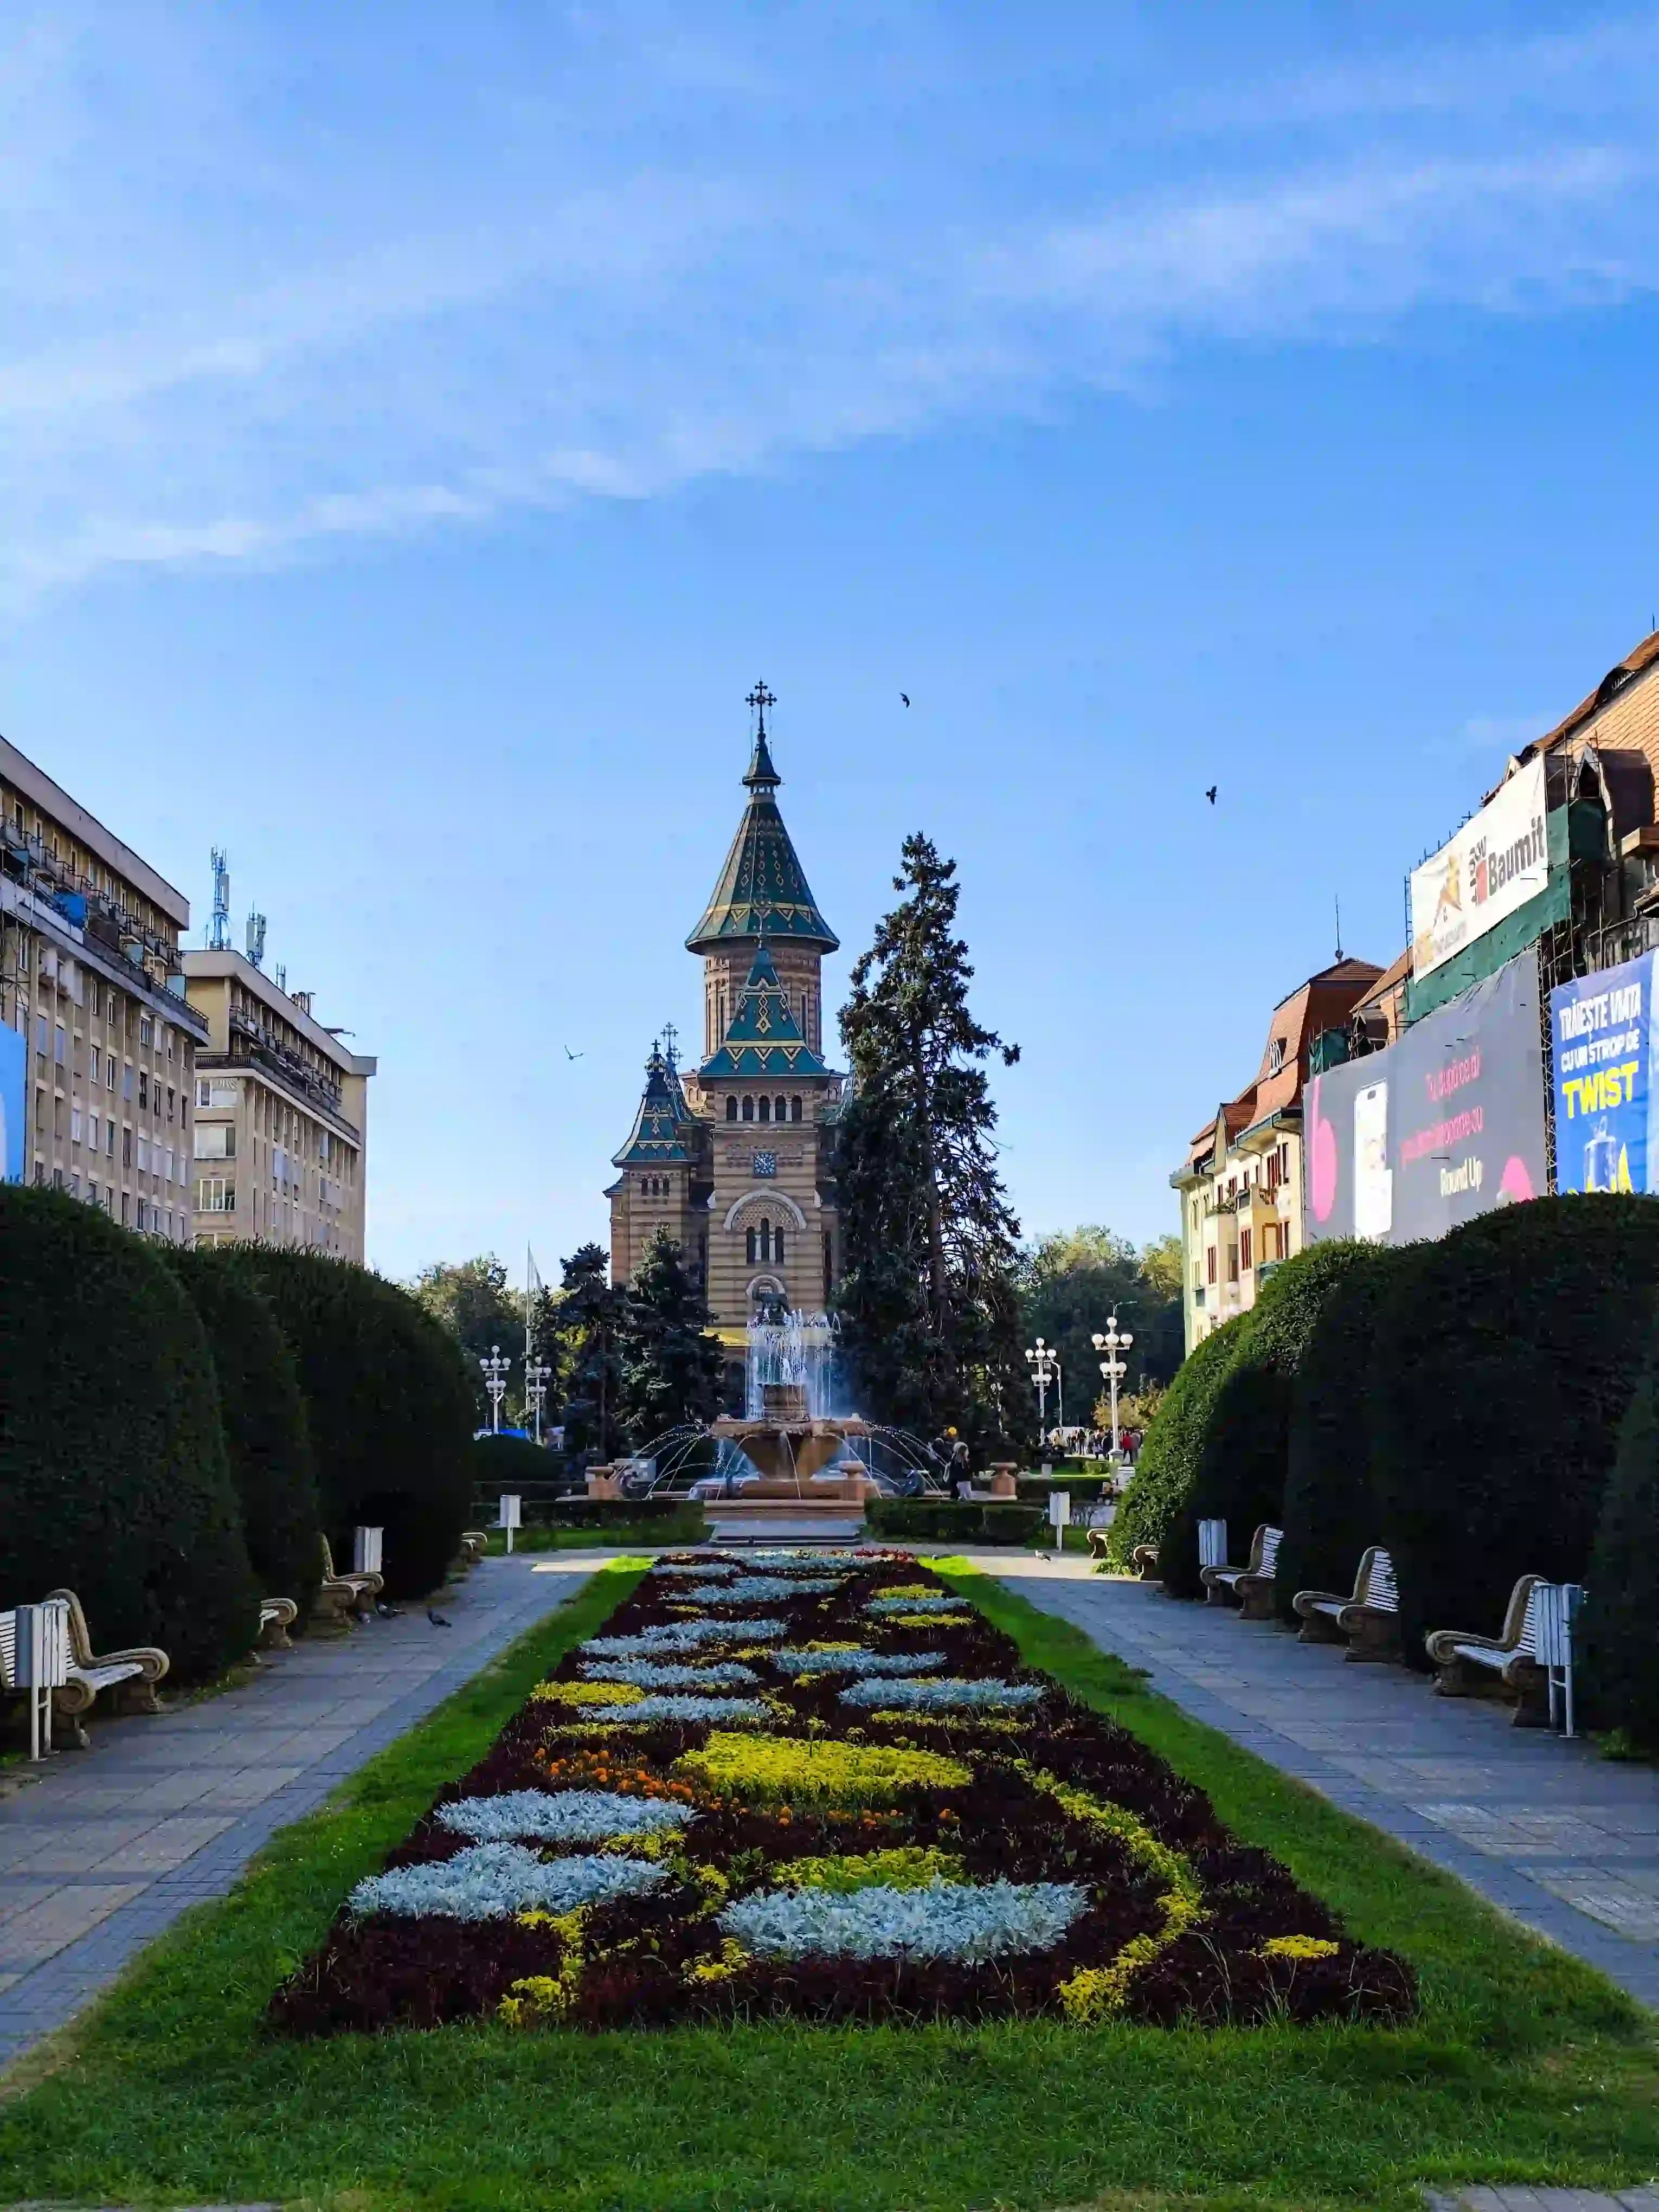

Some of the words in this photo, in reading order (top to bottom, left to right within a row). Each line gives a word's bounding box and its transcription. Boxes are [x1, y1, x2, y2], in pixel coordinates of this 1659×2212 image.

[1488, 815, 1545, 896] Baumit
[1561, 1050, 1574, 1073] CU
[1589, 1034, 1625, 1064] STROP
[1625, 1028, 1640, 1053] DE
[1562, 1060, 1639, 1119] TWIST
[1469, 1155, 1483, 1193] Up
